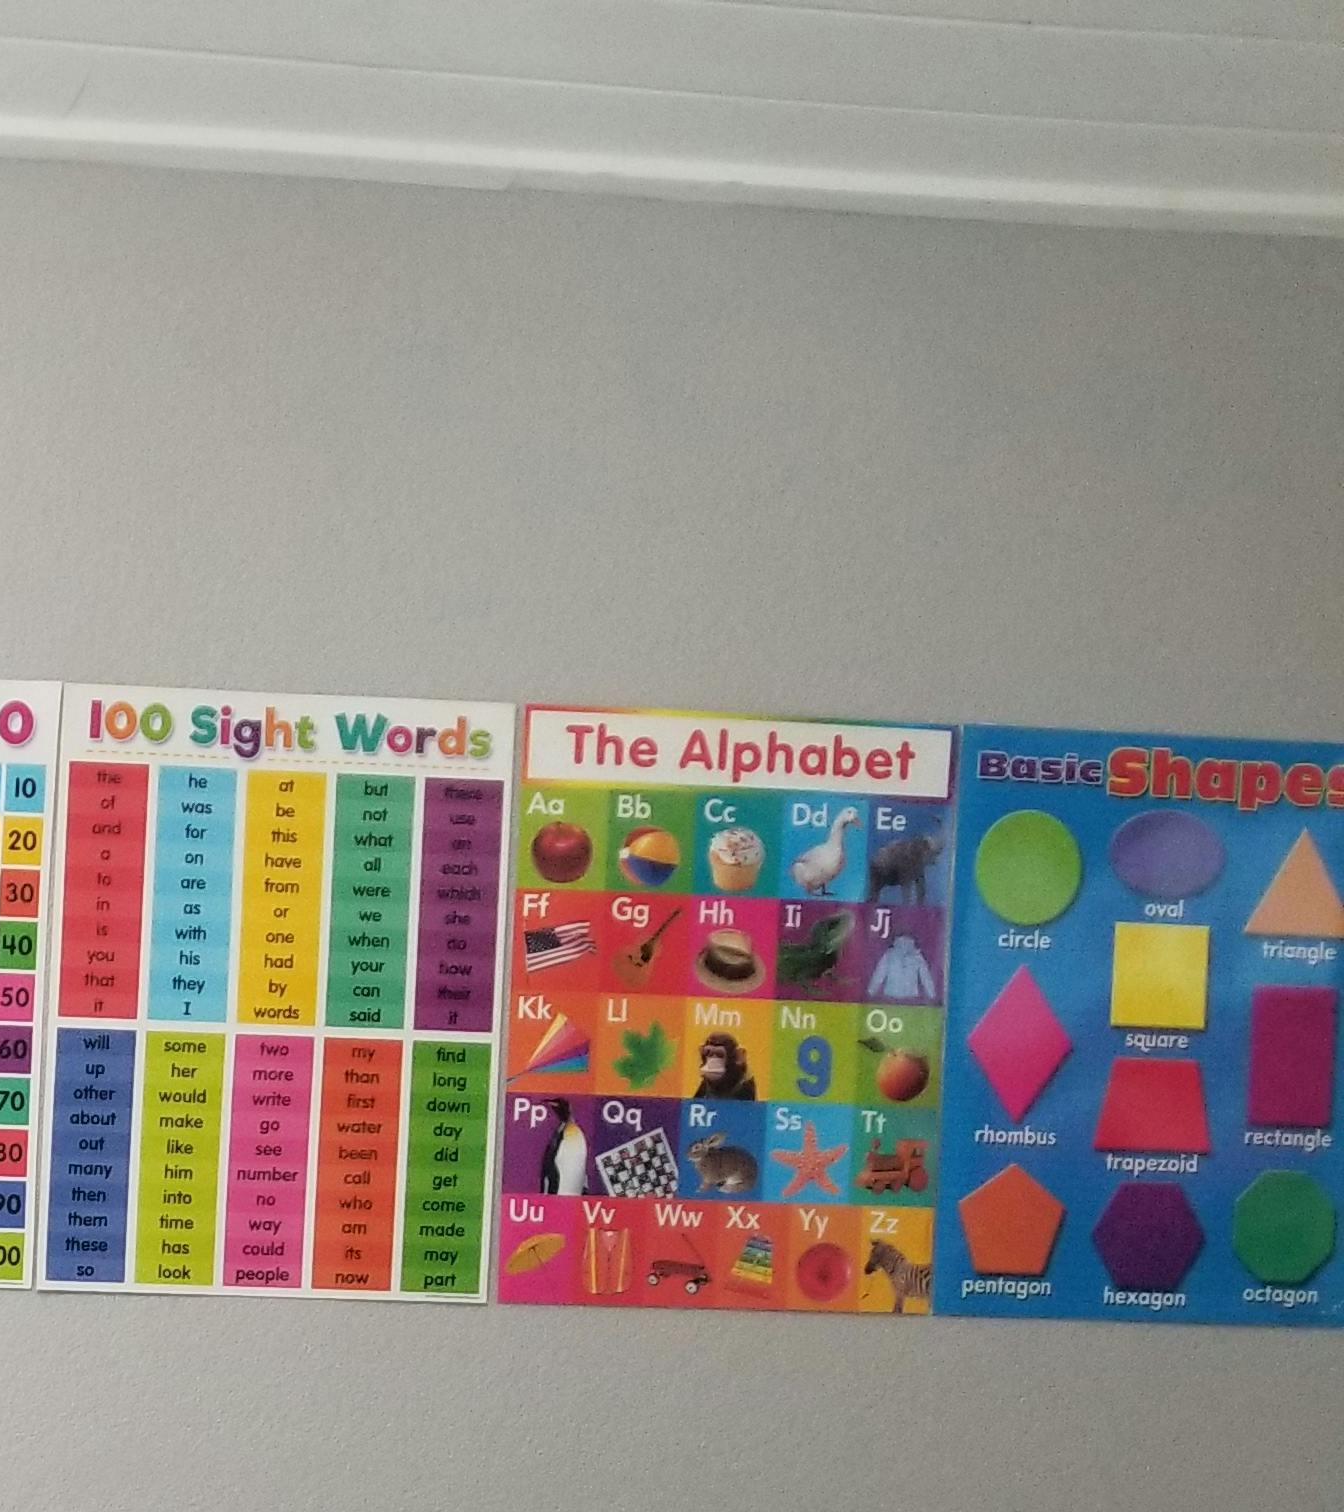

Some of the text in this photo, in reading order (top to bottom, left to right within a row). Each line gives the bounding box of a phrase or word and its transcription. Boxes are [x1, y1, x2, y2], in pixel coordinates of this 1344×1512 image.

[88, 699, 492, 759] 100 Sight Words
[566, 724, 916, 782] The Alphabet
[978, 751, 1103, 785] Basic
[14, 777, 37, 799] 10
[188, 772, 208, 789] he
[363, 780, 389, 797] but
[181, 801, 213, 815] was
[362, 807, 389, 822] not
[528, 792, 906, 831] Aa Bb Cc Dd Ee
[184, 823, 207, 840] for
[353, 831, 394, 848] what
[184, 852, 204, 866] on
[363, 856, 382, 873] all
[180, 878, 207, 890] are
[352, 885, 392, 898] were
[183, 903, 201, 915] as
[358, 910, 383, 923] we
[523, 895, 890, 937] Ff Gg Hh Ii Jj
[1145, 900, 1183, 918] oval
[174, 925, 207, 941] with
[347, 931, 390, 949] when
[998, 930, 1051, 950] circle
[2, 934, 33, 956] 40
[1263, 942, 1336, 964] triangle
[179, 949, 201, 966] his
[350, 960, 386, 976] your
[172, 974, 206, 995] they
[352, 985, 381, 998] can
[181, 1000, 193, 1017] I
[348, 1007, 382, 1023] said
[518, 998, 902, 1033] Kk Ll Mm Nn Oo
[163, 1041, 207, 1054] some
[1125, 1031, 1188, 1054] square
[436, 1046, 466, 1064] find
[170, 1062, 199, 1079] her
[797, 1035, 831, 1096] 9
[432, 1071, 468, 1092] long
[158, 1088, 207, 1104] would
[426, 1096, 471, 1114] down
[159, 1113, 204, 1129] make
[514, 1100, 886, 1132] Pp Qq Rr Ss Tt
[432, 1122, 463, 1142] day
[974, 1126, 1056, 1146] rhombus
[1245, 1128, 1332, 1149] rectangle
[166, 1138, 194, 1155] like
[433, 1147, 459, 1163] did
[164, 1163, 194, 1180] him
[1106, 1154, 1198, 1174] trapezoid
[432, 1173, 459, 1191] get
[163, 1190, 193, 1205] into
[422, 1200, 466, 1213] come
[159, 1213, 194, 1230] time
[510, 1201, 897, 1237] Uu Vv Ww Xx Yy Zz
[418, 1222, 465, 1238] made
[161, 1238, 190, 1255] has
[423, 1250, 459, 1266] may
[157, 1263, 191, 1280] look
[423, 1273, 457, 1290] part
[962, 1277, 1051, 1297] pentagon
[1103, 1288, 1185, 1308] hexagon
[1243, 1285, 1318, 1305] octagon
